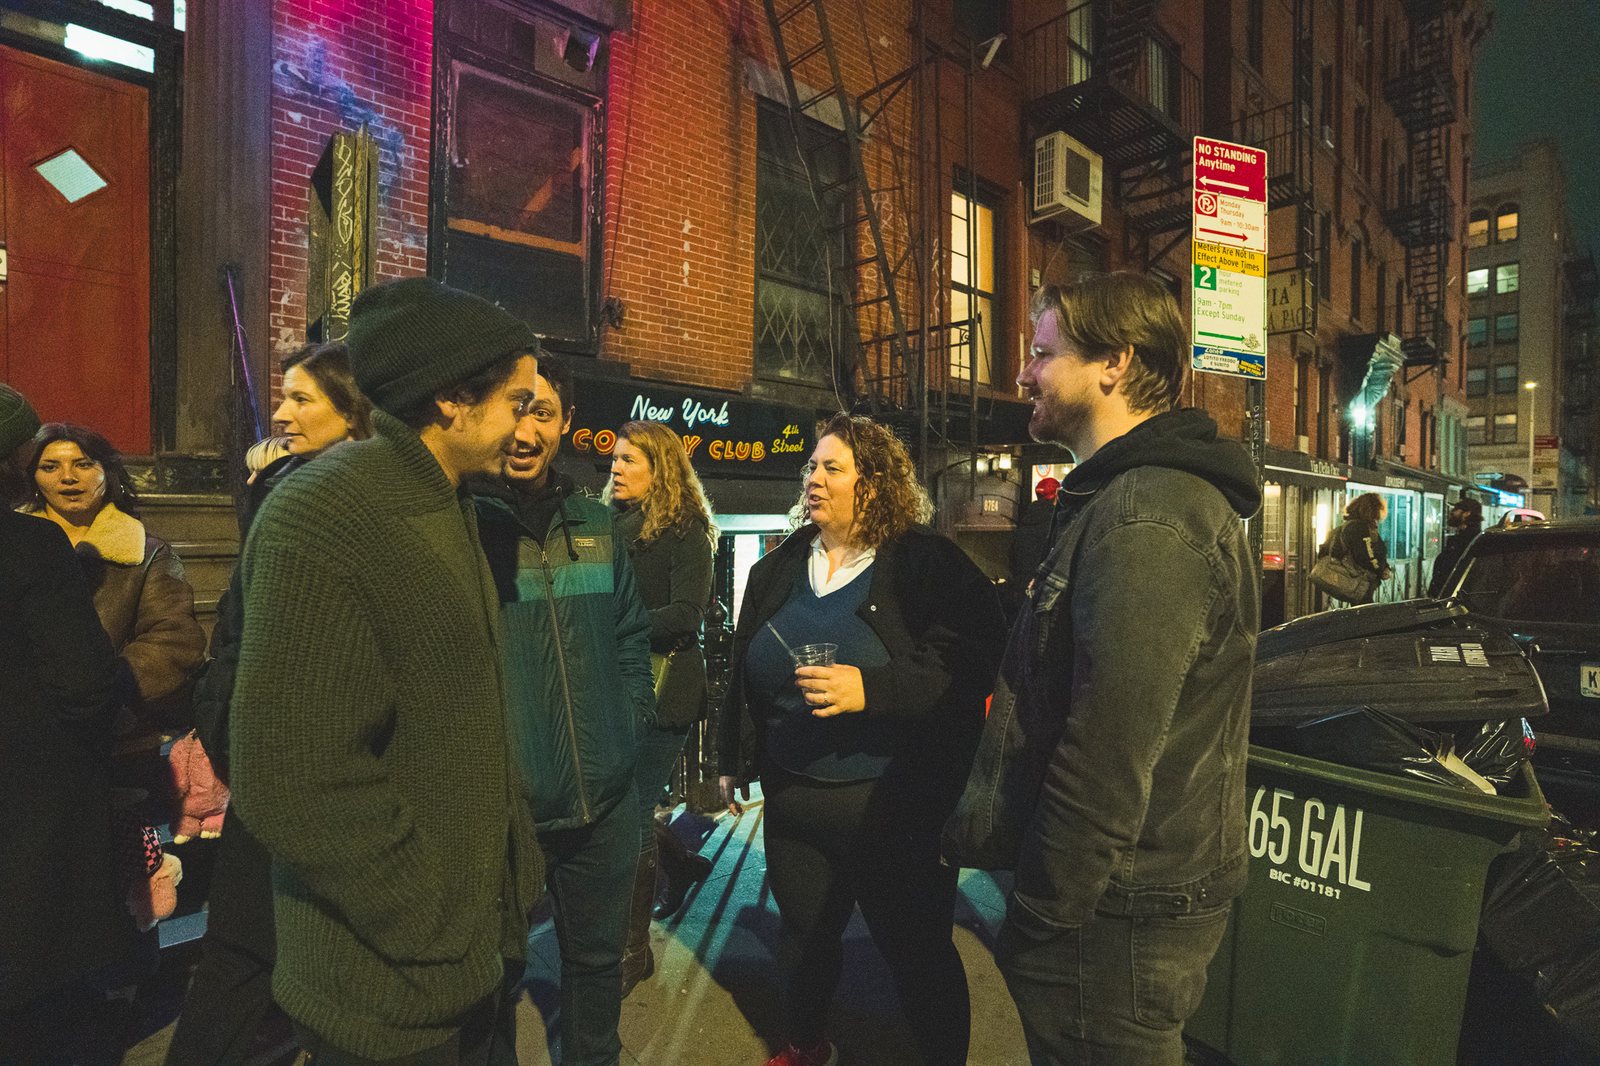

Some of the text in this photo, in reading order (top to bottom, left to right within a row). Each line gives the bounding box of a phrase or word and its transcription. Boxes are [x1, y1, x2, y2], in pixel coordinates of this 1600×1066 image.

[1198, 143, 1257, 165] NO STANDING
[1199, 156, 1236, 172] Anytime
[1220, 199, 1241, 210] Monday
[1220, 208, 1245, 219] Thursday
[1220, 219, 1232, 227] 9am
[1237, 221, 1260, 231] 10:30am
[1197, 241, 1255, 260] Meters Are Not In
[1197, 252, 1260, 271] Effect Above Times
[1199, 266, 1212, 288] 2
[1219, 279, 1243, 288] metered
[1219, 286, 1240, 296] parking
[1267, 287, 1290, 306] IA
[1197, 297, 1212, 307] 9am
[1218, 299, 1233, 311] 7pm
[1197, 306, 1245, 323] Except Sunday
[630, 394, 730, 428] New York
[782, 424, 800, 439] 4th
[572, 428, 767, 462] COY CLUB
[771, 437, 804, 454] Street
[1248, 785, 1372, 892] 65 GAL
[1269, 868, 1342, 900] BIC #01181
